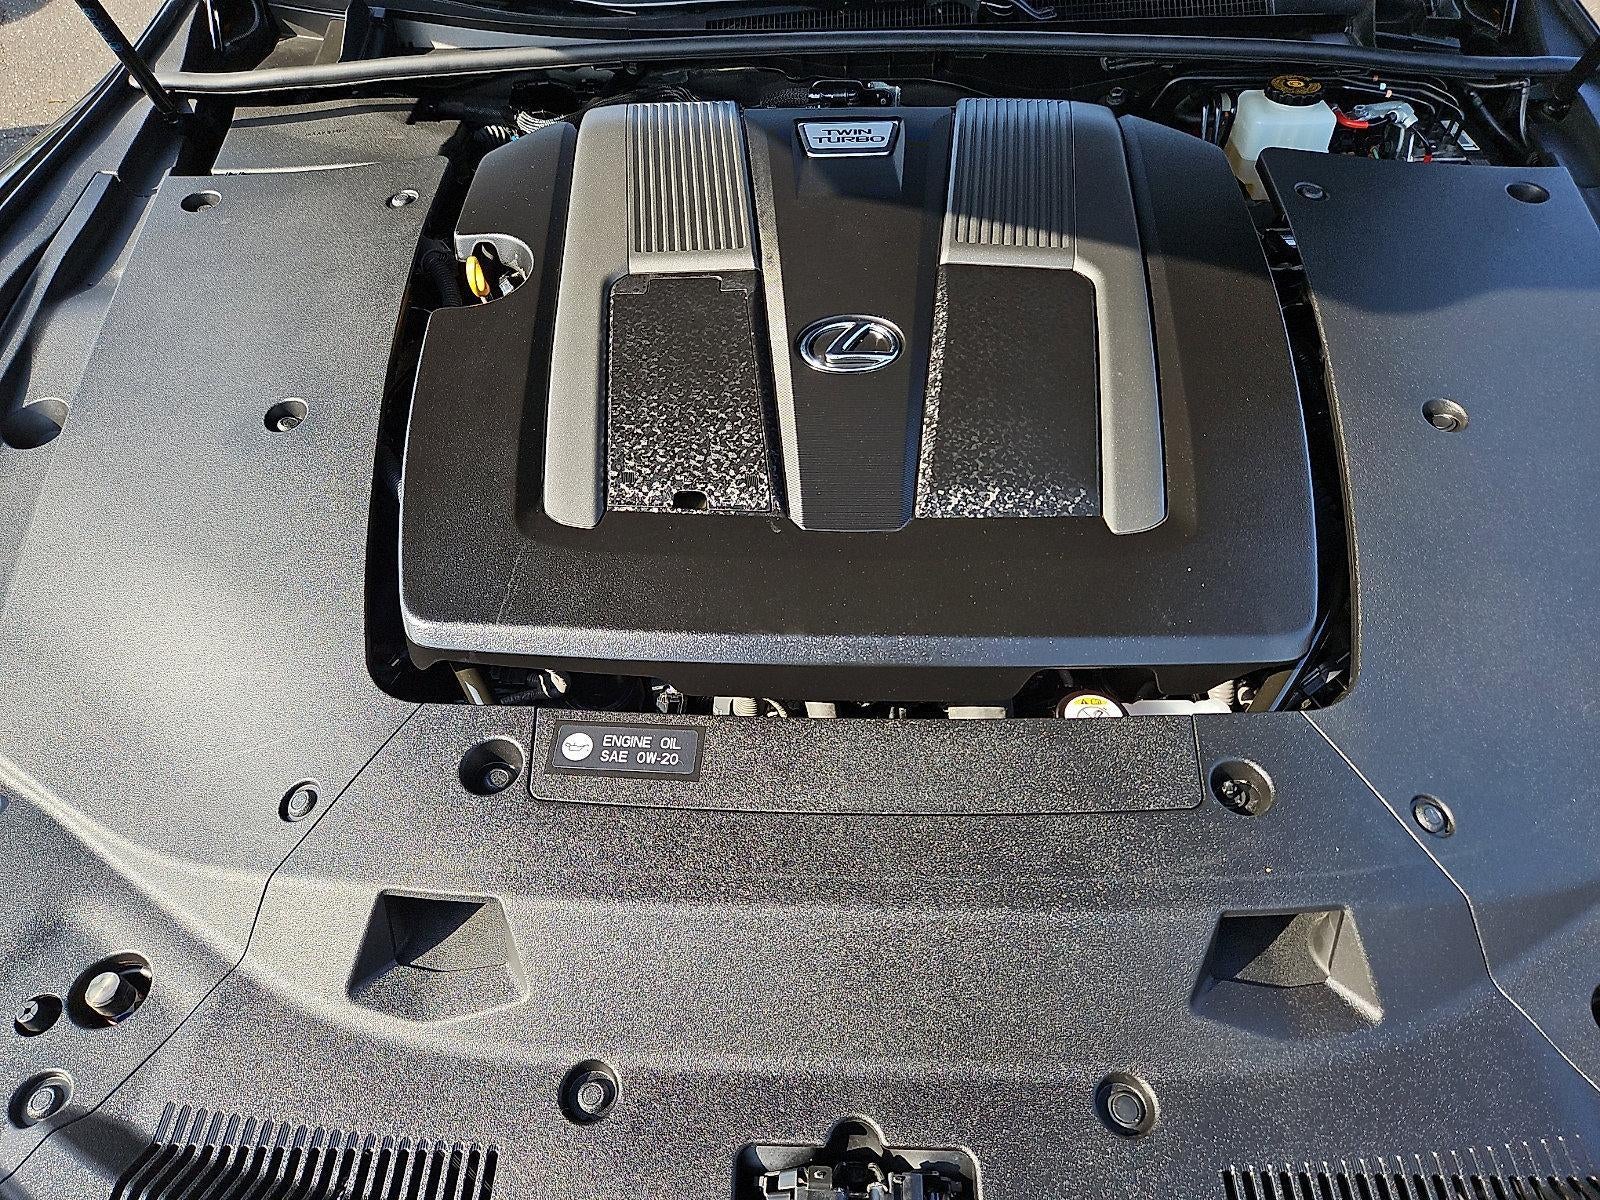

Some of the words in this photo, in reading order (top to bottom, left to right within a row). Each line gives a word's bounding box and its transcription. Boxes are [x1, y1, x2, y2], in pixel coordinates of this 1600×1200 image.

[602, 734, 652, 748] ENGINE
[660, 736, 682, 750] OIL
[600, 749, 629, 763] SAE
[636, 751, 679, 765] 0W-20
